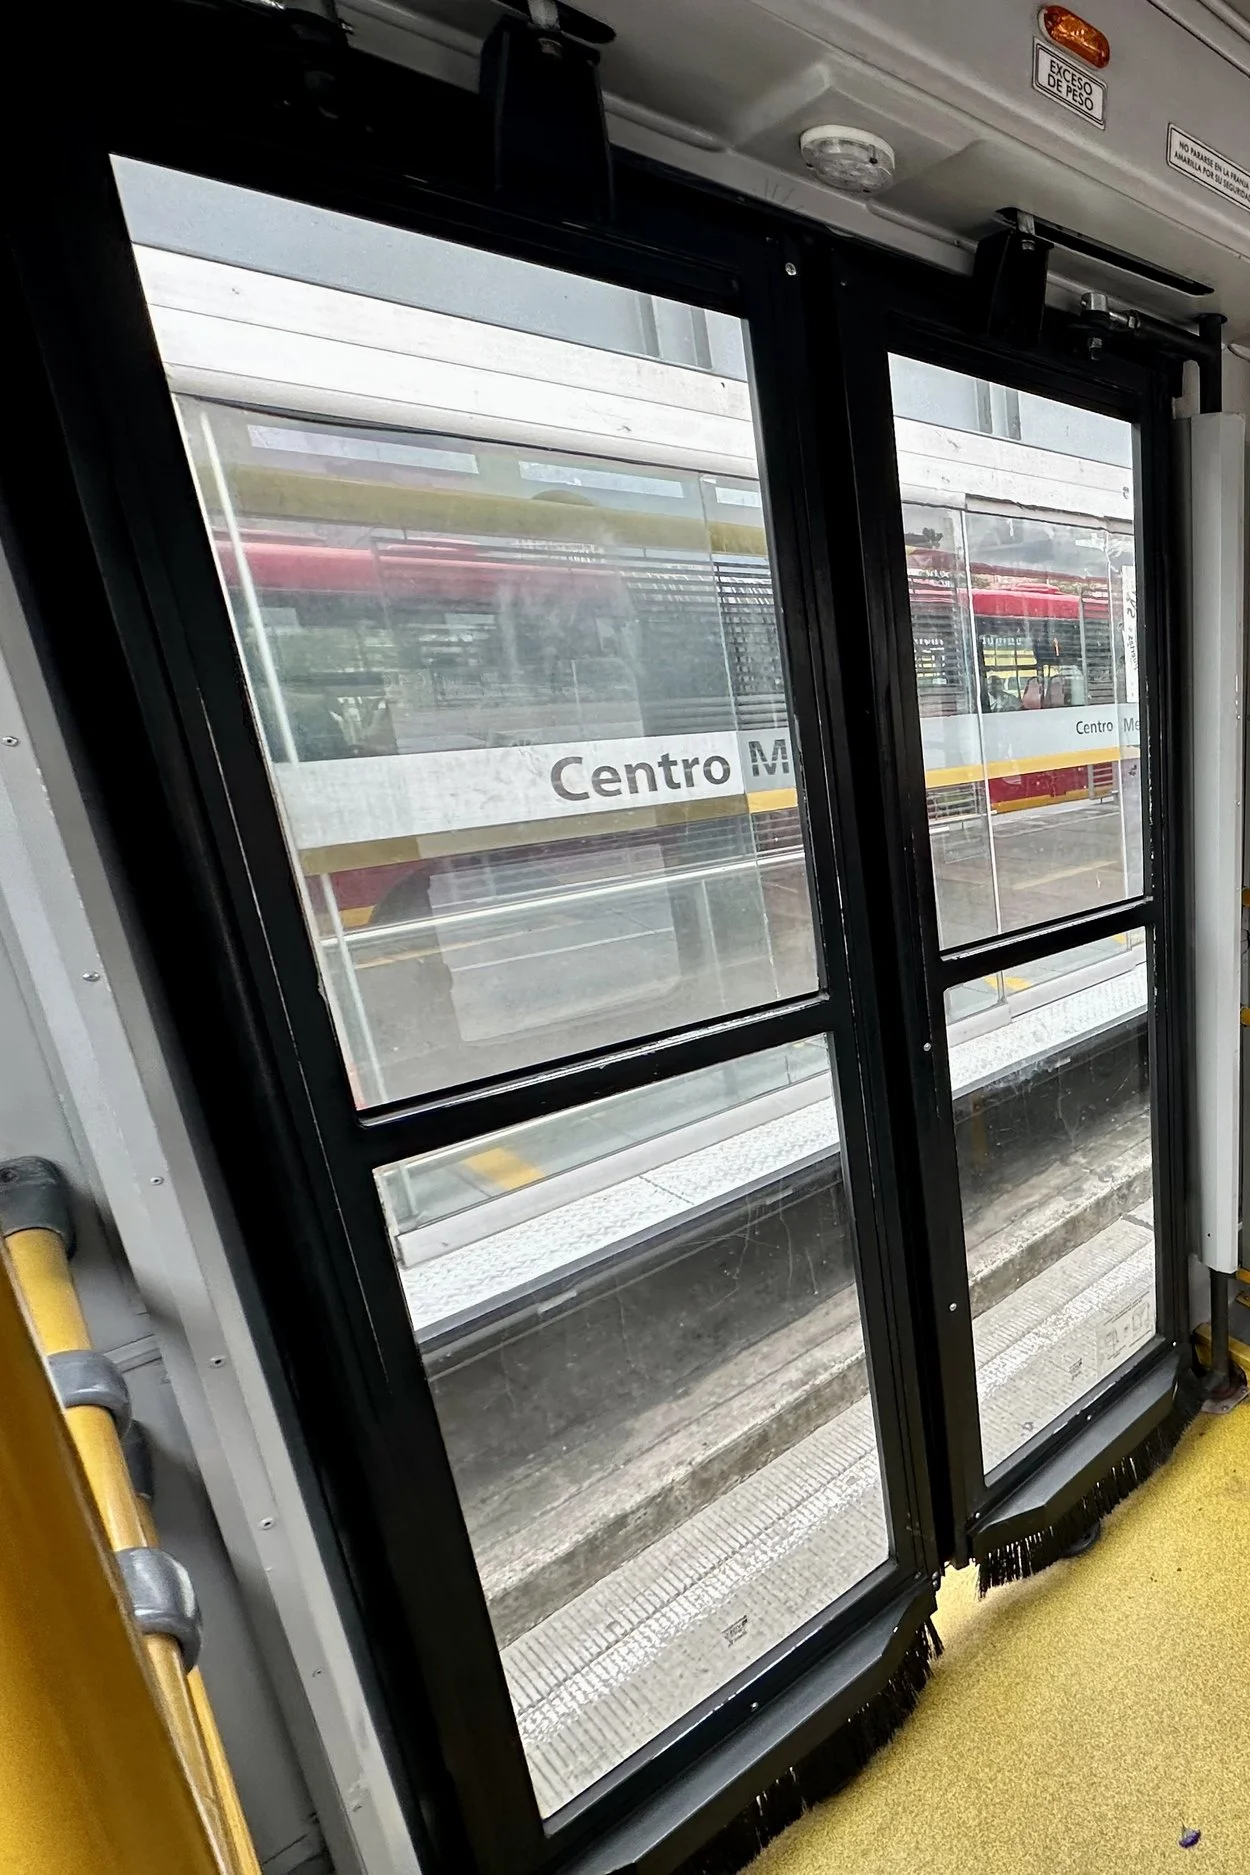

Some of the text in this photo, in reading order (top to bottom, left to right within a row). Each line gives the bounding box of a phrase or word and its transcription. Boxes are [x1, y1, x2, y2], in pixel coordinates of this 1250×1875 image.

[1048, 73, 1093, 111] DE PESO
[1050, 59, 1093, 95] EXCESO
[1174, 151, 1201, 173] AMARILLA
[1203, 166, 1214, 179] POR
[1215, 174, 1222, 184] SU
[1179, 141, 1250, 189] NO PARARSE EN LA FRANJA
[1076, 720, 1113, 734] Centro
[550, 752, 732, 802] Centro
